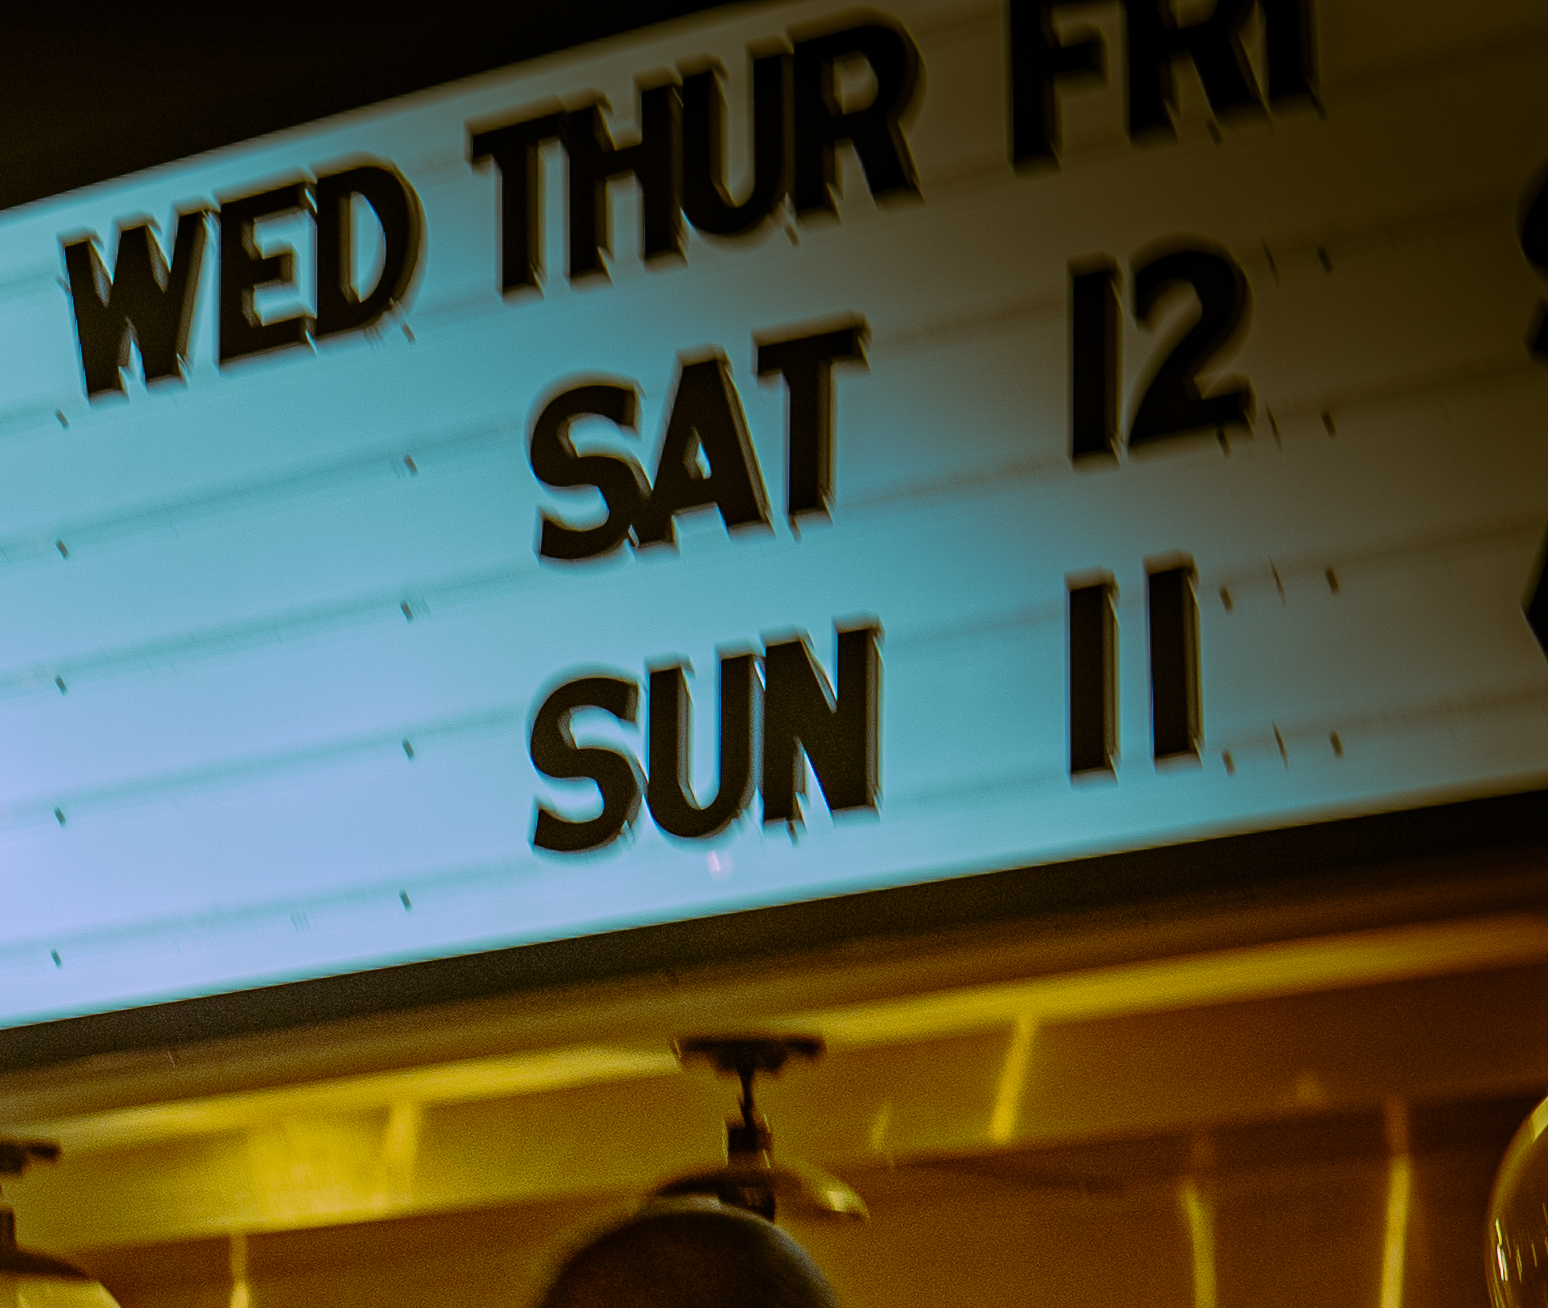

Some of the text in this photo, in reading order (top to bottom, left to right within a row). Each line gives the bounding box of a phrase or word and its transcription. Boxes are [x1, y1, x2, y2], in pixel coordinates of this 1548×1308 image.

[62, 0, 1321, 404] WED THUR FRI
[529, 314, 868, 564] SAT
[1066, 236, 1255, 467] 12
[527, 552, 1204, 856] SUN 11
